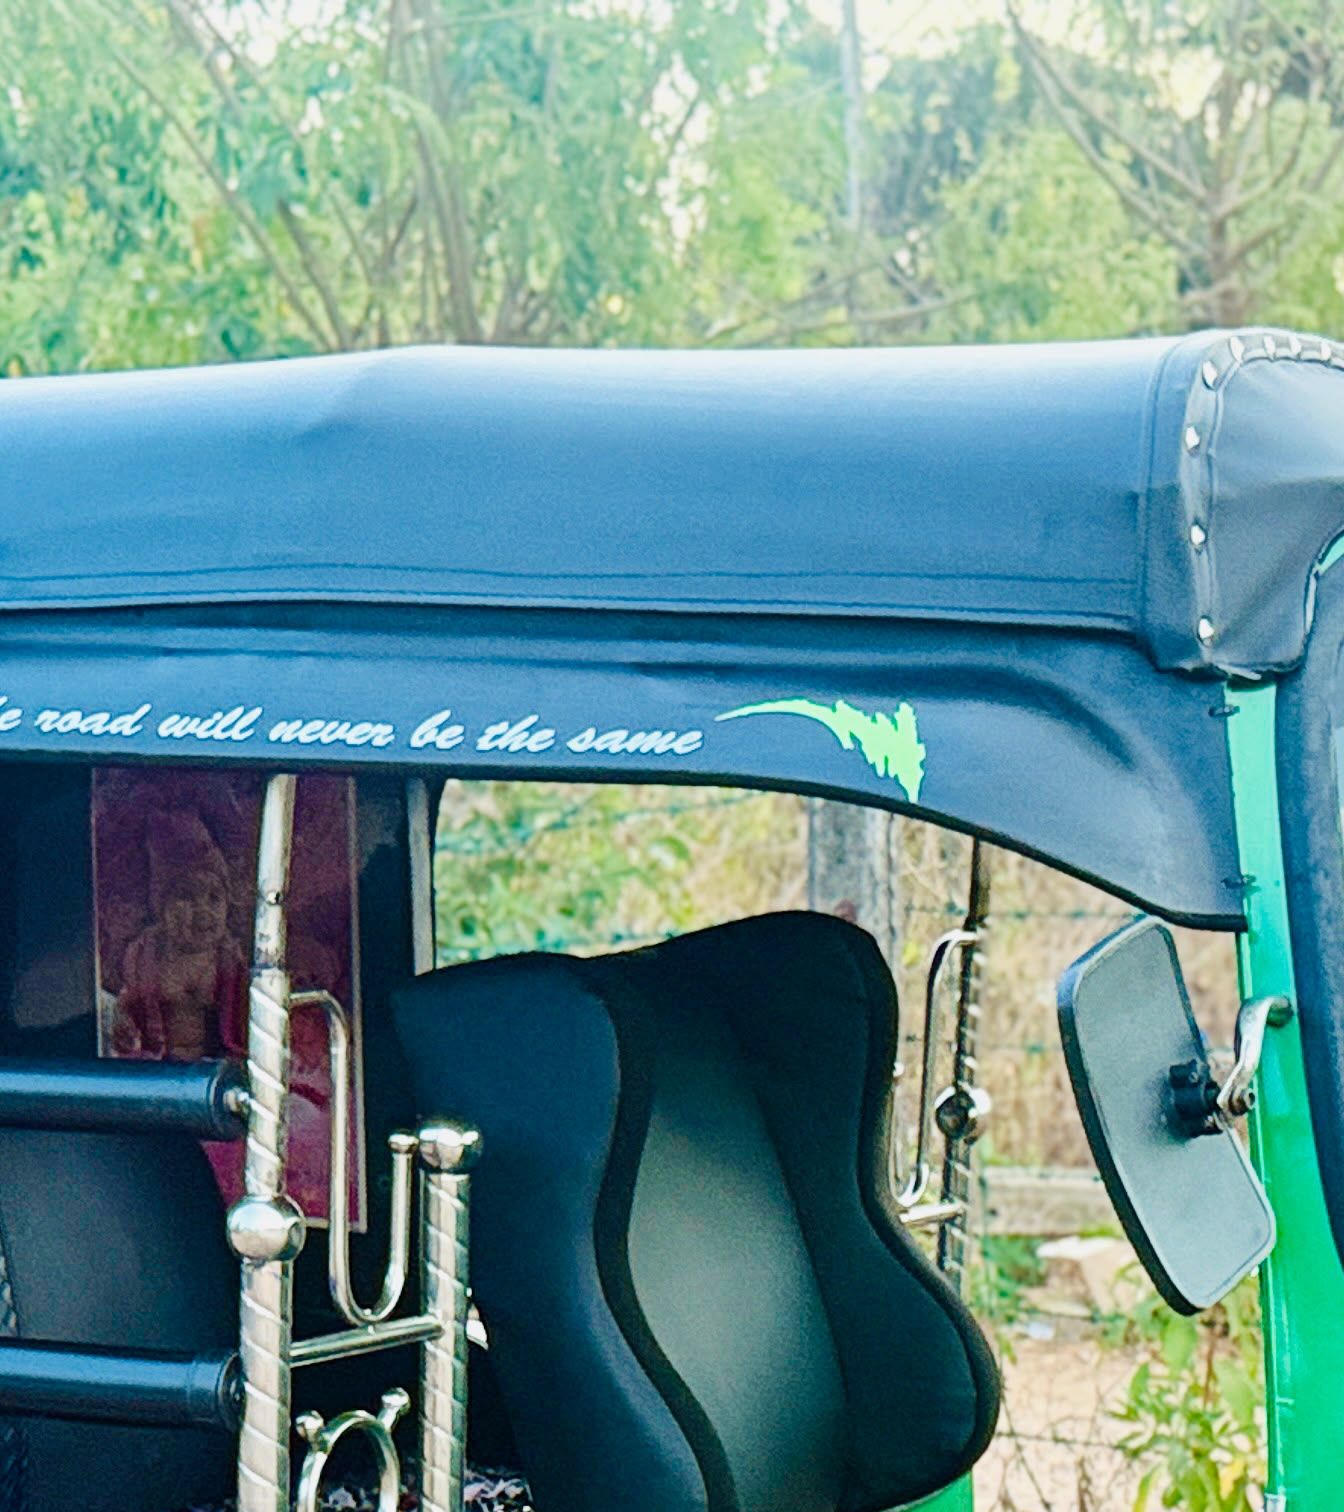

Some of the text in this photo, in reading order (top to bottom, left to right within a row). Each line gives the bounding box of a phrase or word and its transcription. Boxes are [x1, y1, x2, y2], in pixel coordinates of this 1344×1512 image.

[34, 703, 153, 737] road
[157, 705, 264, 742] will
[268, 717, 395, 748] never
[409, 709, 465, 750] be
[475, 714, 556, 753] the
[566, 726, 705, 756] same
